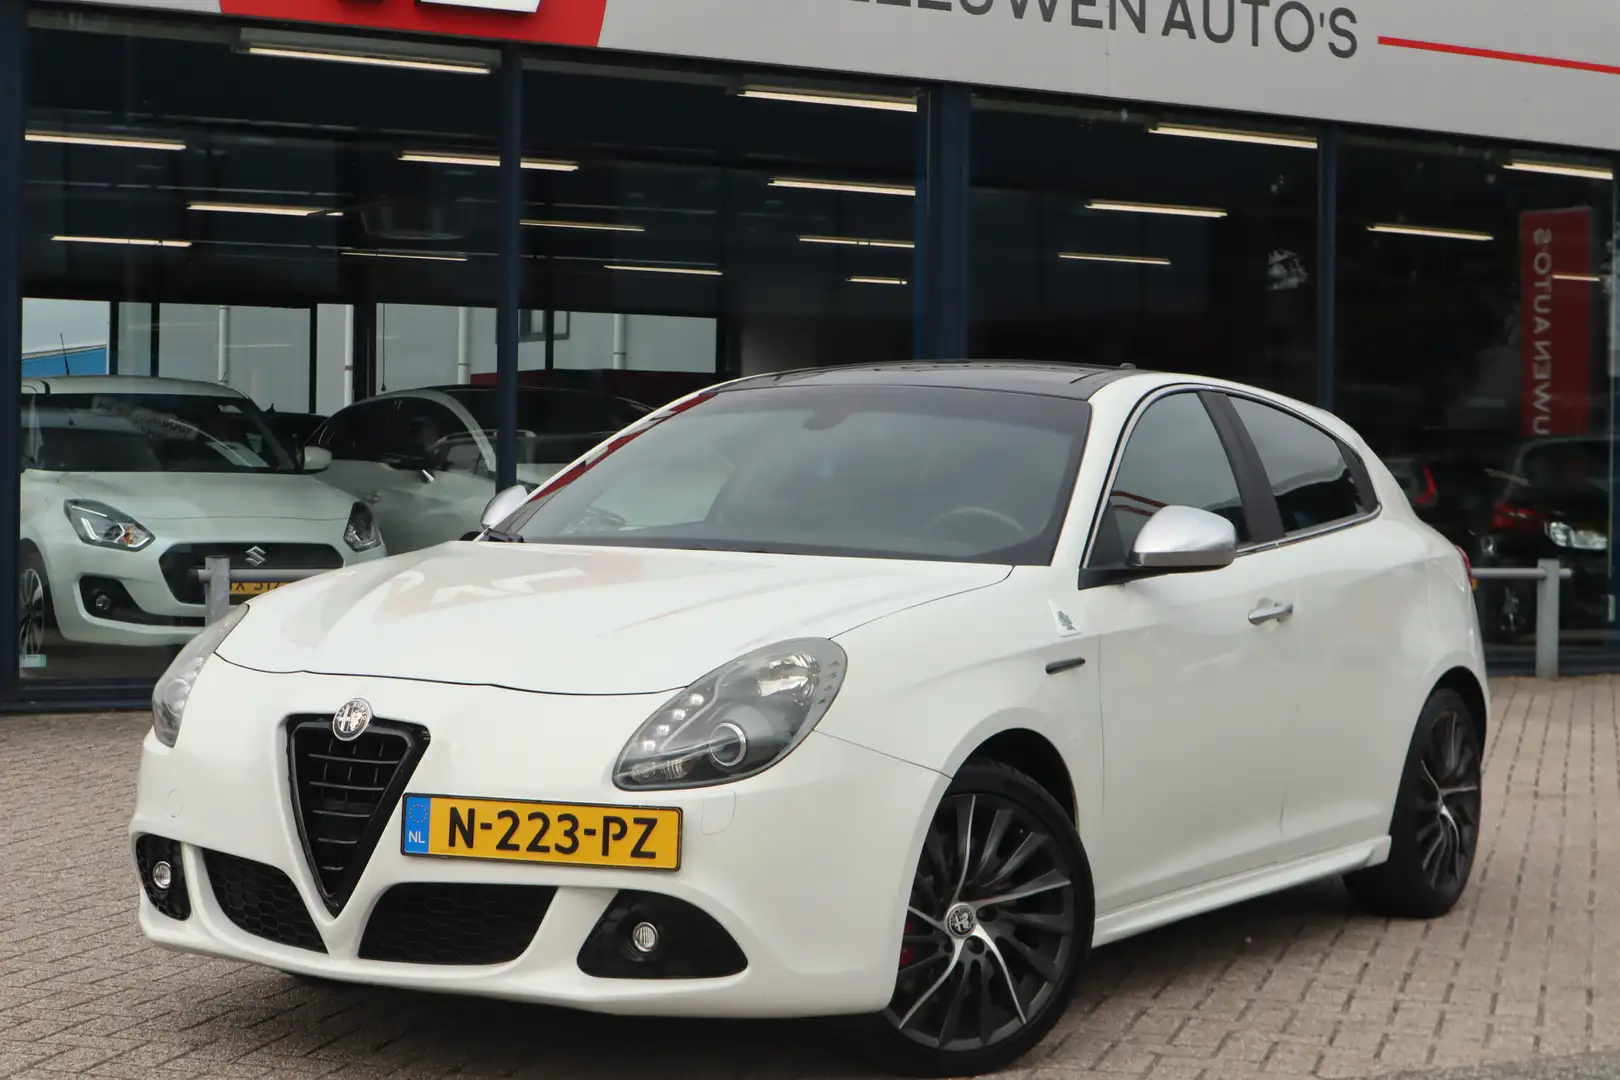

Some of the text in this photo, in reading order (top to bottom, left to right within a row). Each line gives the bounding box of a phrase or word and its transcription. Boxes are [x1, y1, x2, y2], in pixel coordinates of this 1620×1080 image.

[1161, 0, 1357, 58] AUTO'S
[408, 831, 425, 844] NL
[448, 806, 658, 859] N-223-PZ
